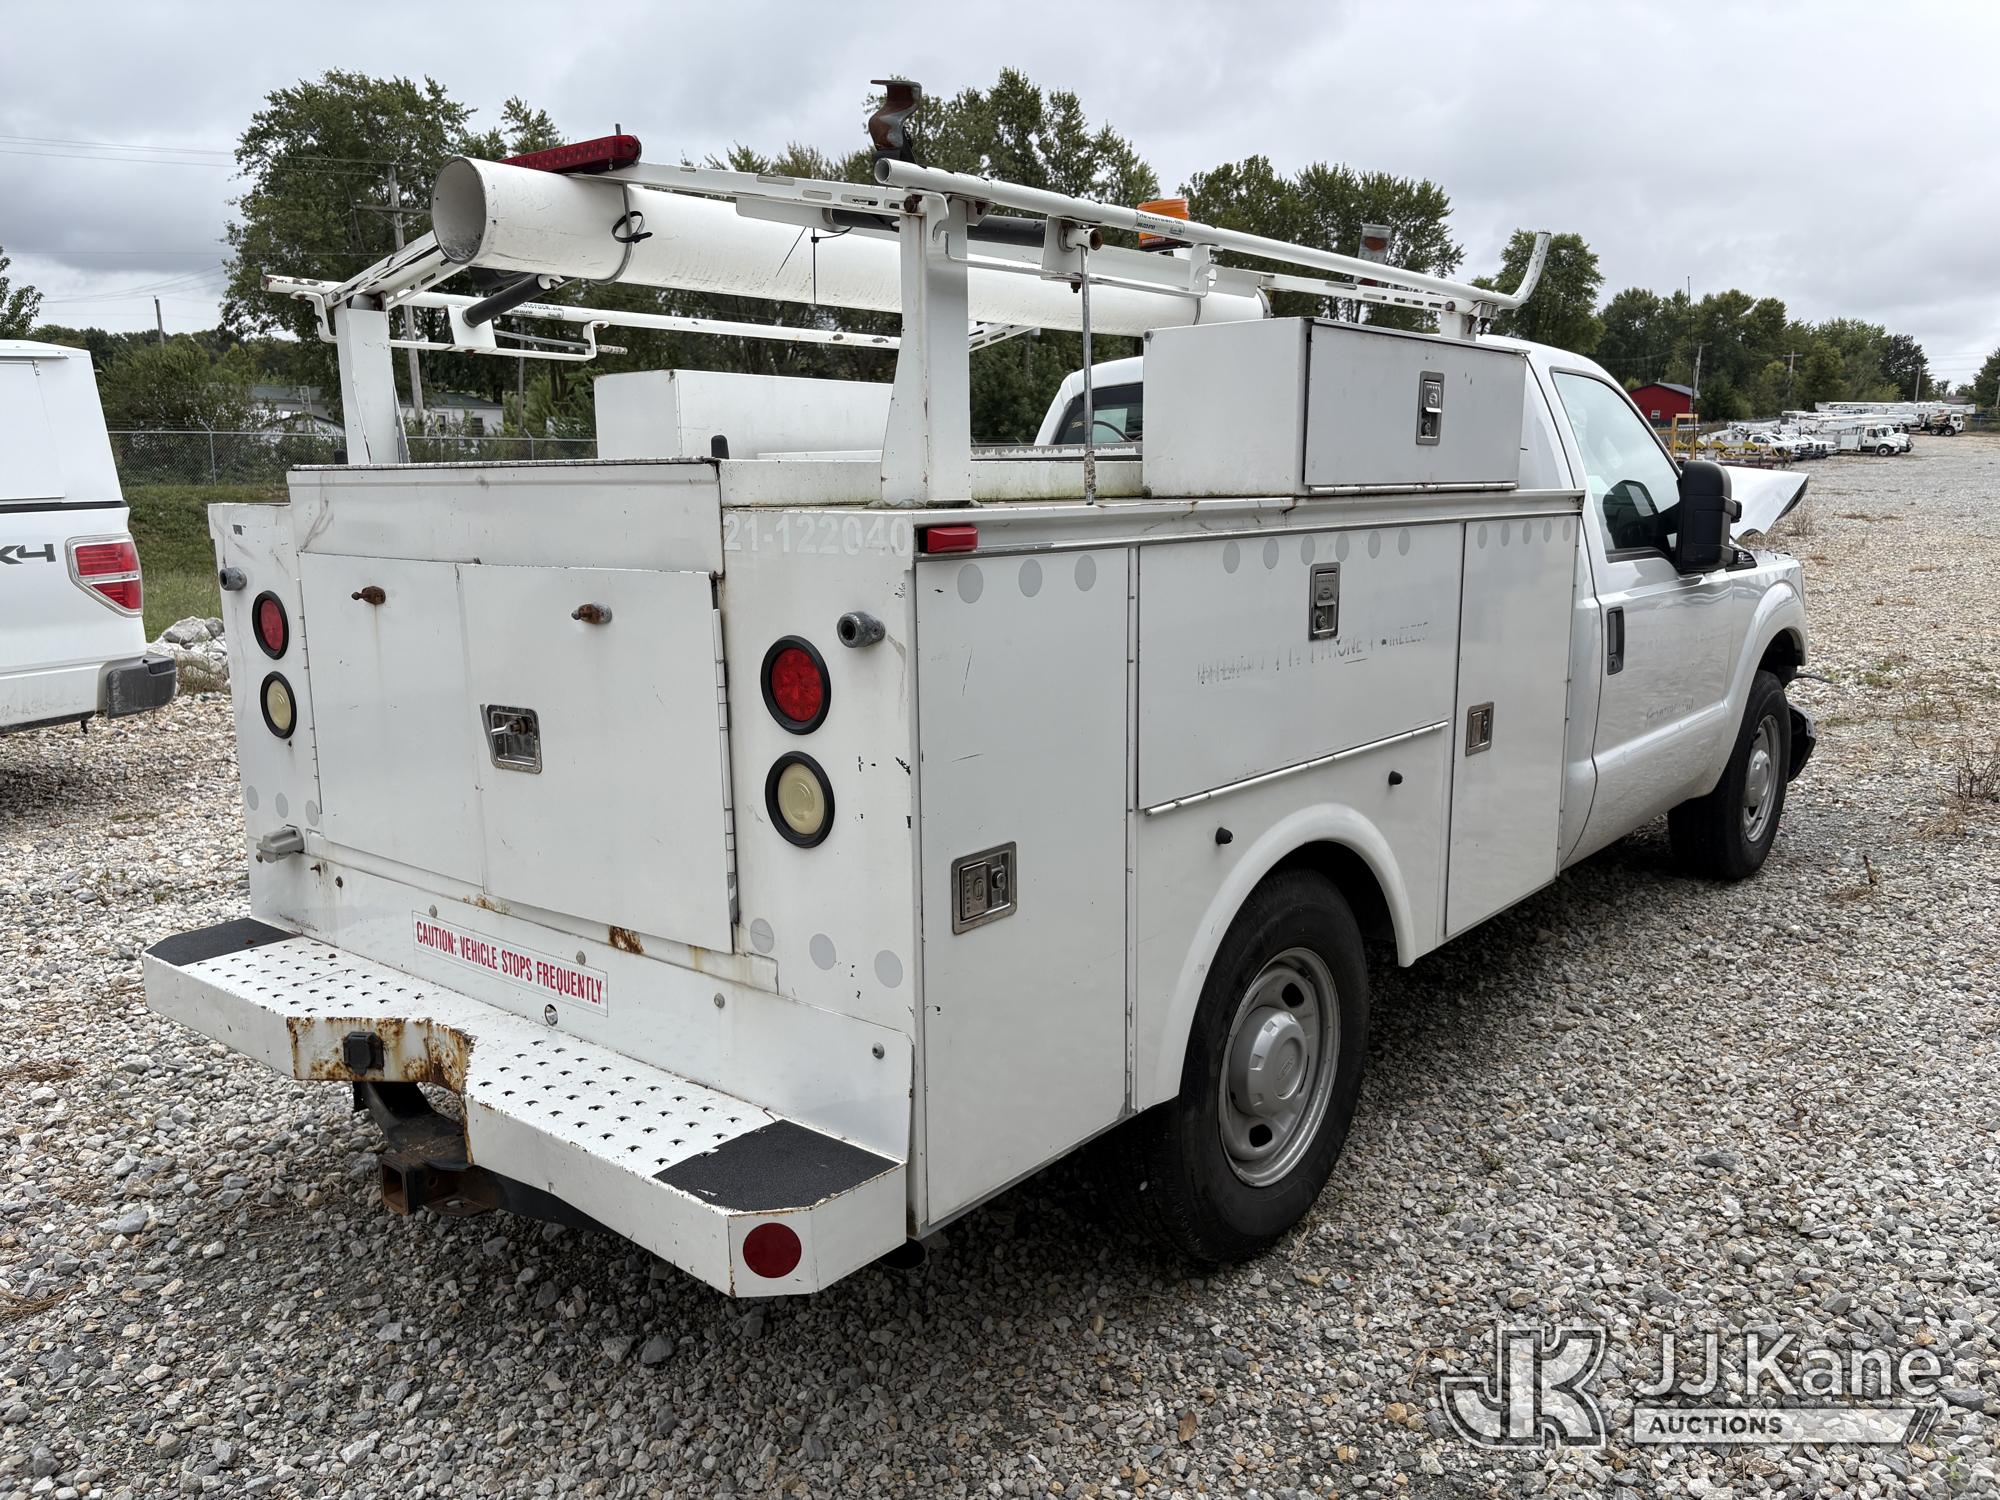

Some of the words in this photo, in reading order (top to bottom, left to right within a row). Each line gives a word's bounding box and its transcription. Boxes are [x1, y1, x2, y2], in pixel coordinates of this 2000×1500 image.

[722, 513, 913, 556] 21-122040
[416, 920, 457, 956] CAUTION:
[459, 935, 498, 970] VEHICLE
[501, 949, 533, 982] STOPS
[536, 961, 603, 1005] FREQUENTLY
